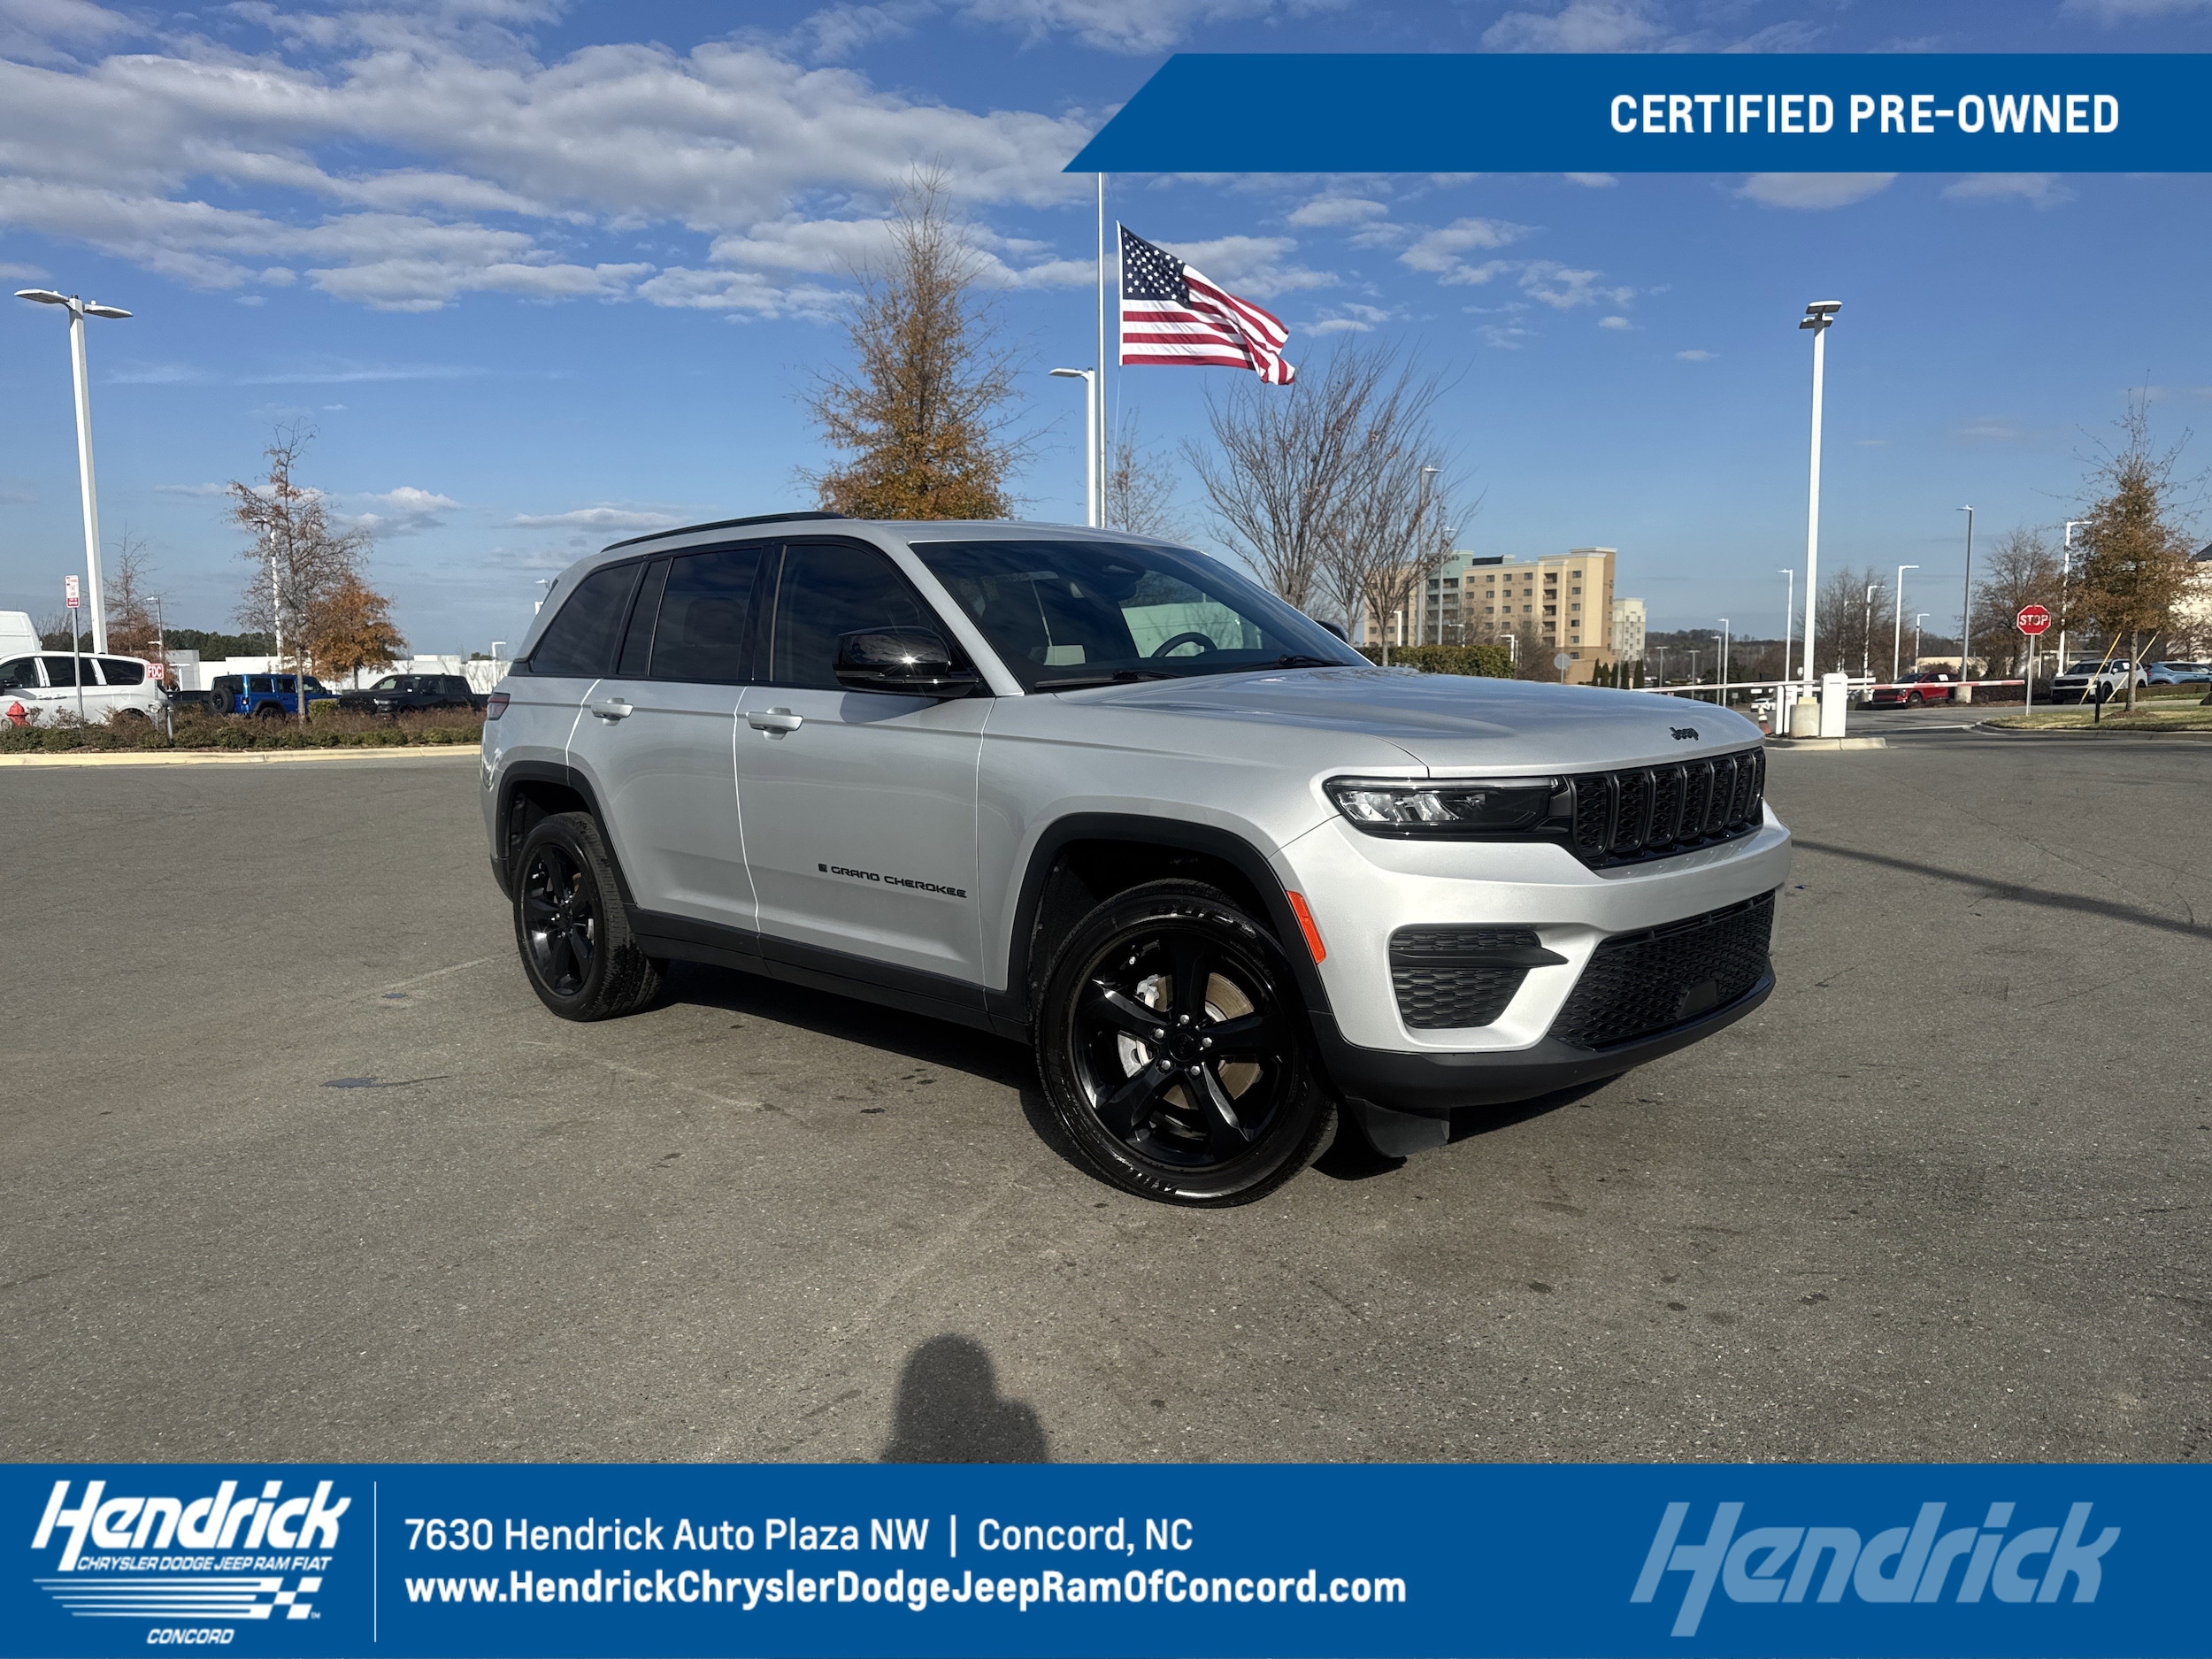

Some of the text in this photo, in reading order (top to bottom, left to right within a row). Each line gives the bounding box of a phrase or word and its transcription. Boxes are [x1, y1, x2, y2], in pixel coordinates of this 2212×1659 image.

[2019, 614, 2049, 626] STOP
[148, 665, 162, 678] FDC
[1669, 726, 1700, 741] Jeep
[831, 865, 967, 899] GRAND CHEROKEE
